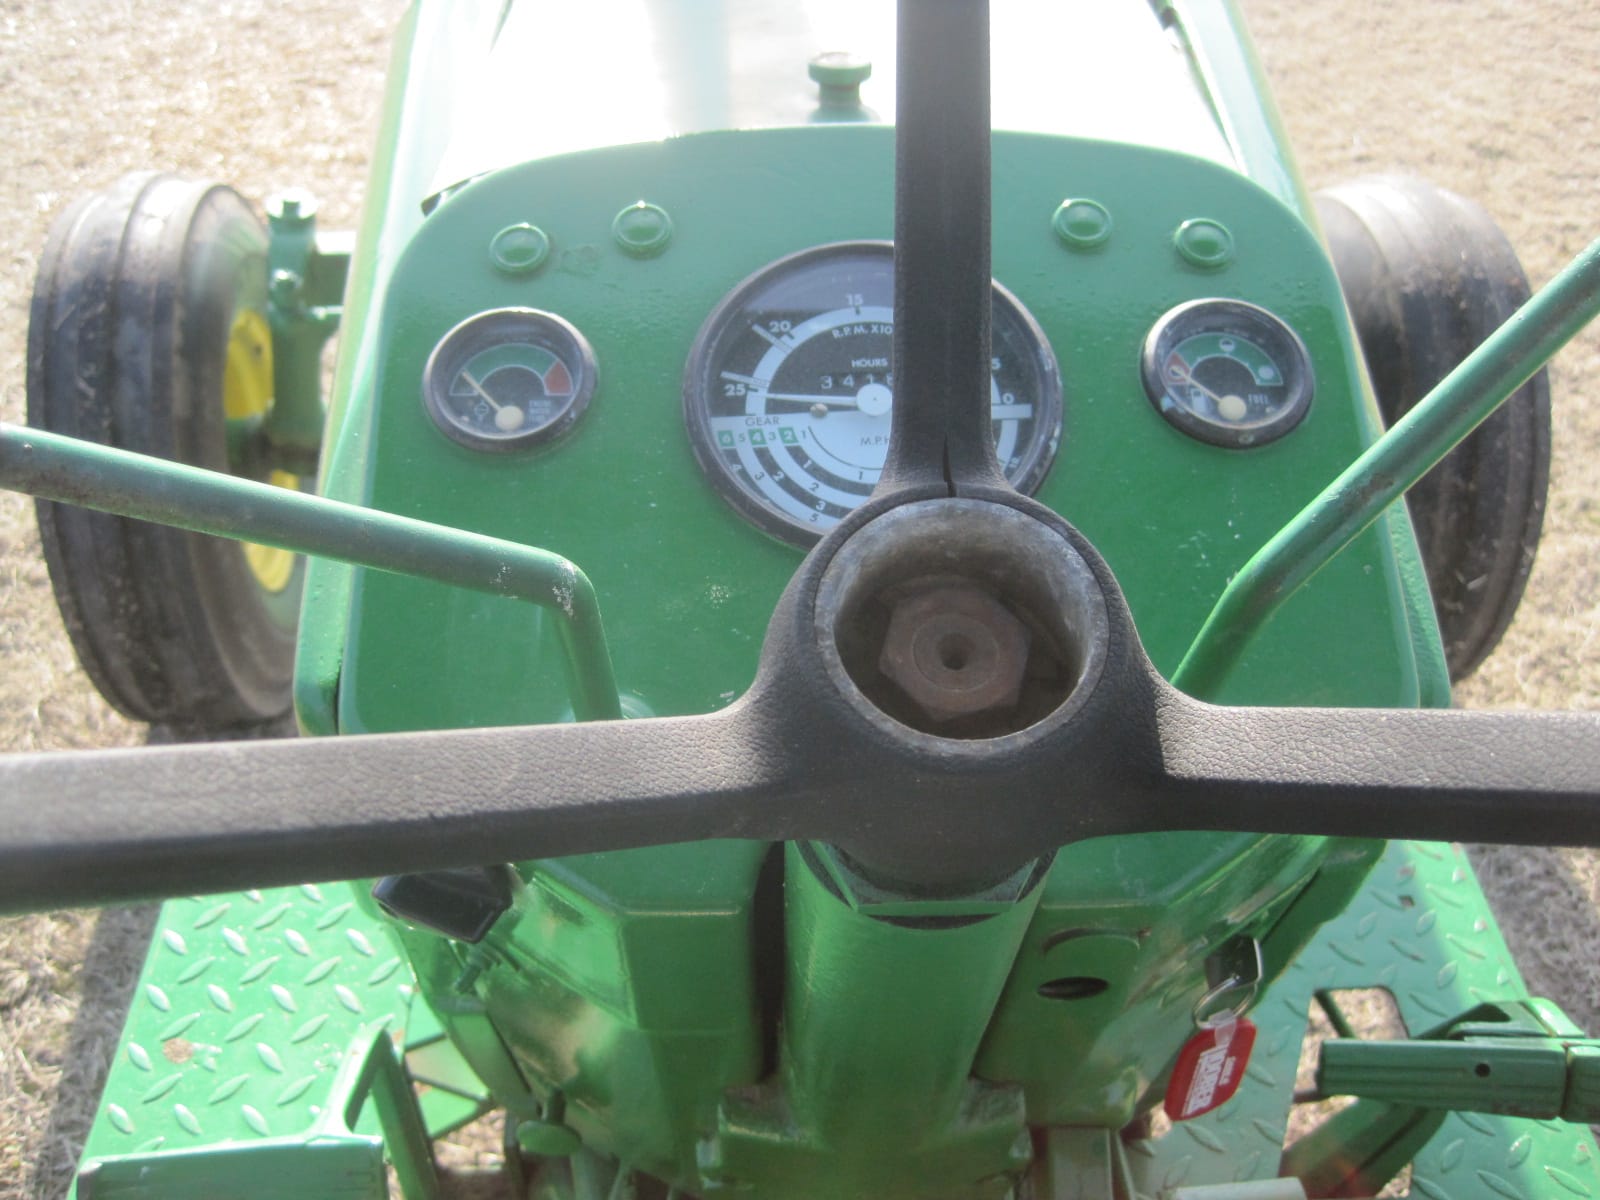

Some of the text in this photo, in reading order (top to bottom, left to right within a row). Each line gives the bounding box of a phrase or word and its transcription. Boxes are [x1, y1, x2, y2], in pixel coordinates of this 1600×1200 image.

[846, 293, 864, 306] 15
[768, 320, 792, 333] 20
[832, 325, 869, 339] R.P.M.
[851, 358, 889, 368] HOURS
[724, 383, 747, 397] 25
[1002, 392, 1015, 405] 0
[744, 415, 780, 427] GEAR
[767, 430, 777, 441] 3
[754, 471, 766, 481] 3
[772, 470, 785, 483] 2
[808, 481, 820, 492] 2
[814, 500, 827, 512] 3
[808, 512, 819, 523] 5
